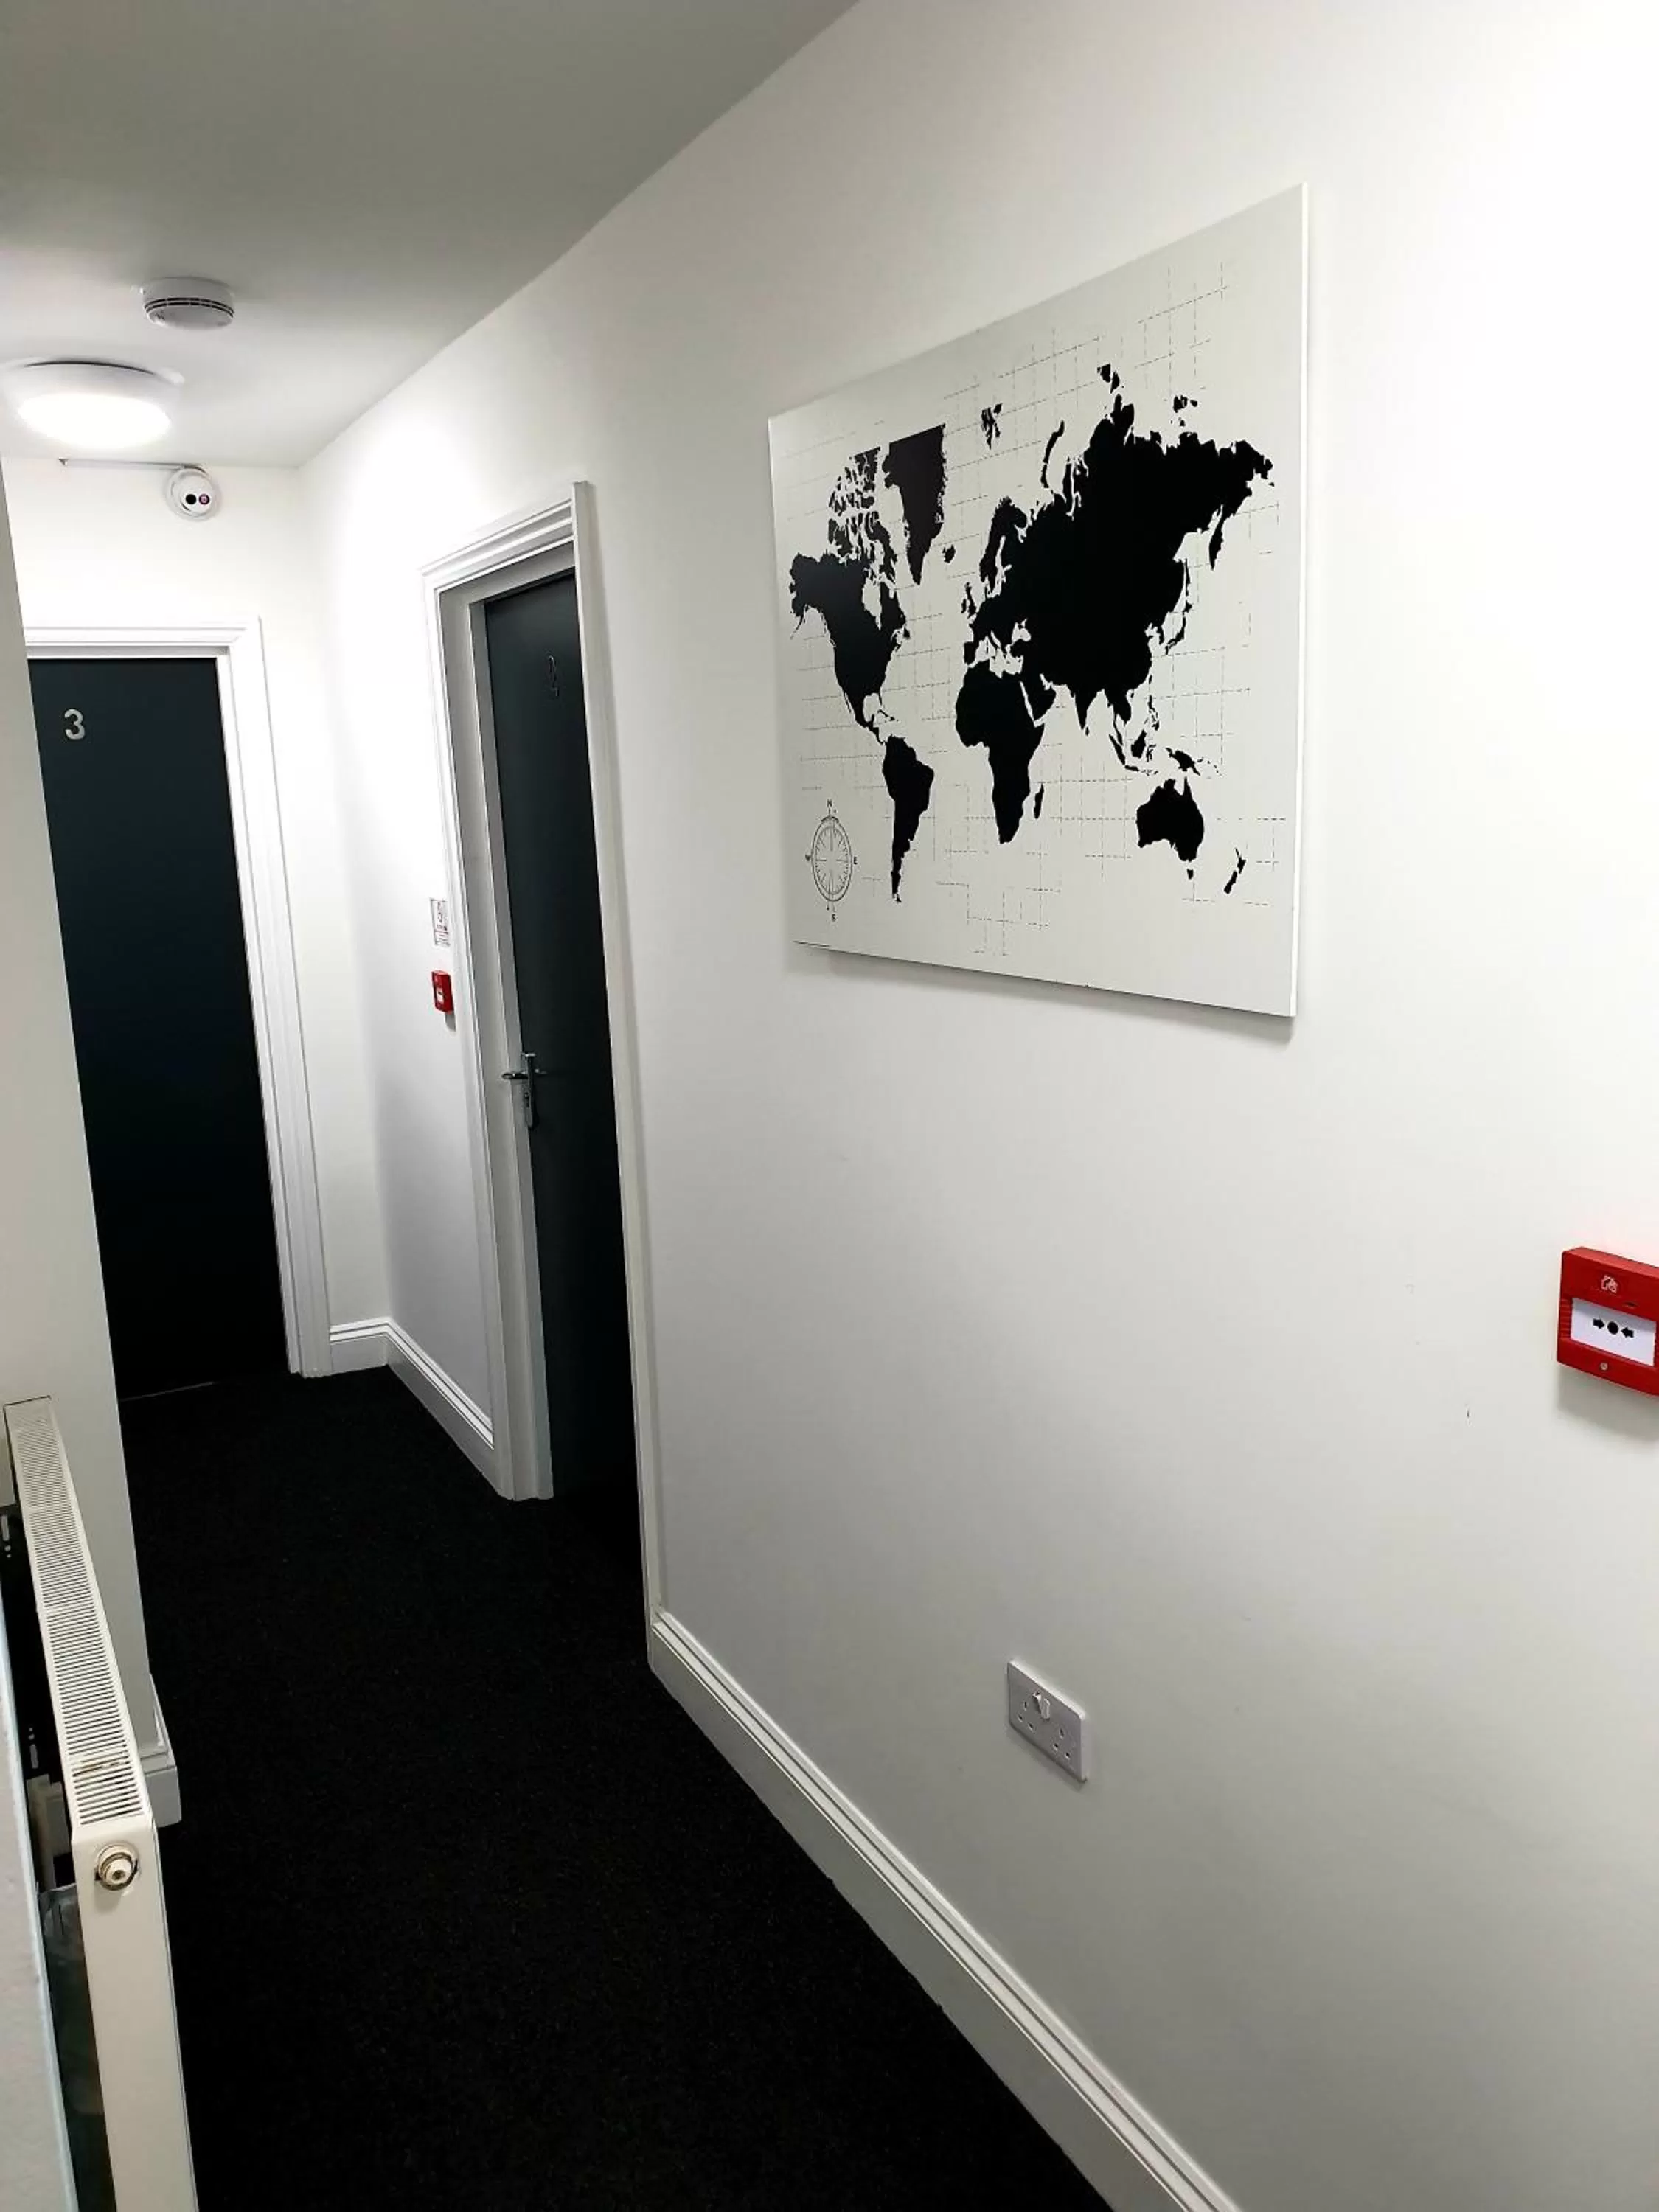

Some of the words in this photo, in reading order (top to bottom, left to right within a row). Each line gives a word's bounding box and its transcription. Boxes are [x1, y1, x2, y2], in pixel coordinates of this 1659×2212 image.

[64, 709, 85, 740] 3
[827, 799, 832, 807] N
[853, 856, 858, 865] E
